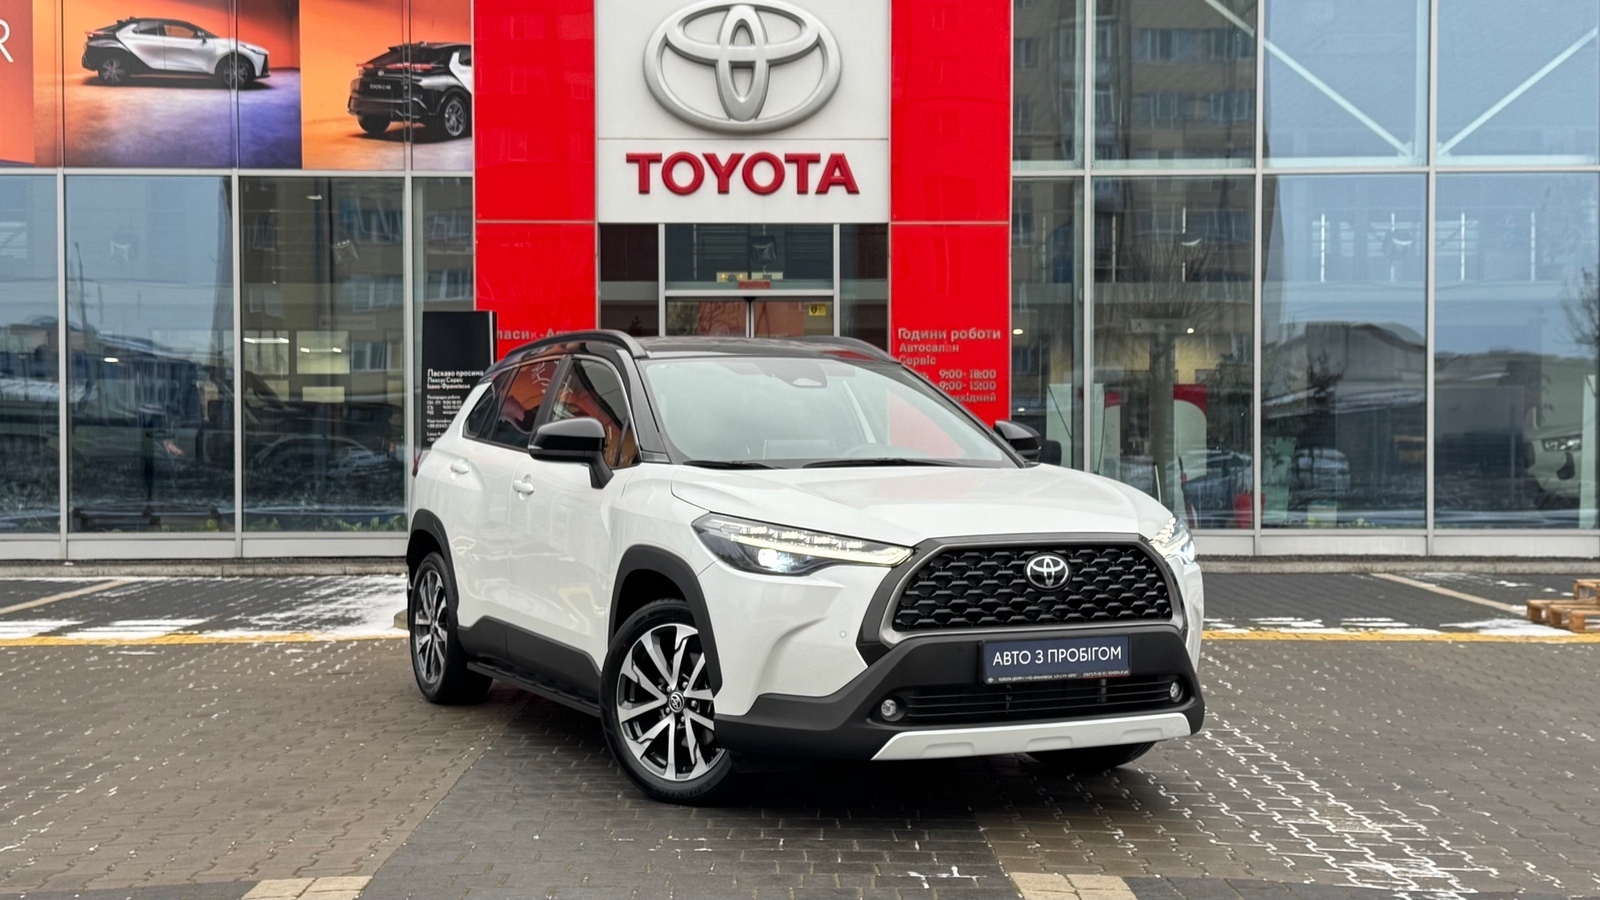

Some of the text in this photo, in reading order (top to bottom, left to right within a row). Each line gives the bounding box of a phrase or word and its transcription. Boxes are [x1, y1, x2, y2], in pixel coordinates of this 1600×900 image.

[626, 151, 860, 196] TOYOTA
[898, 327, 1001, 342] Години роботи
[899, 343, 959, 352] Автосалон
[898, 354, 937, 368] Сервіс
[969, 369, 997, 379] 18:00
[969, 380, 997, 391] 15:00
[992, 645, 1122, 666] АВТО З ПРОБІГОМ
